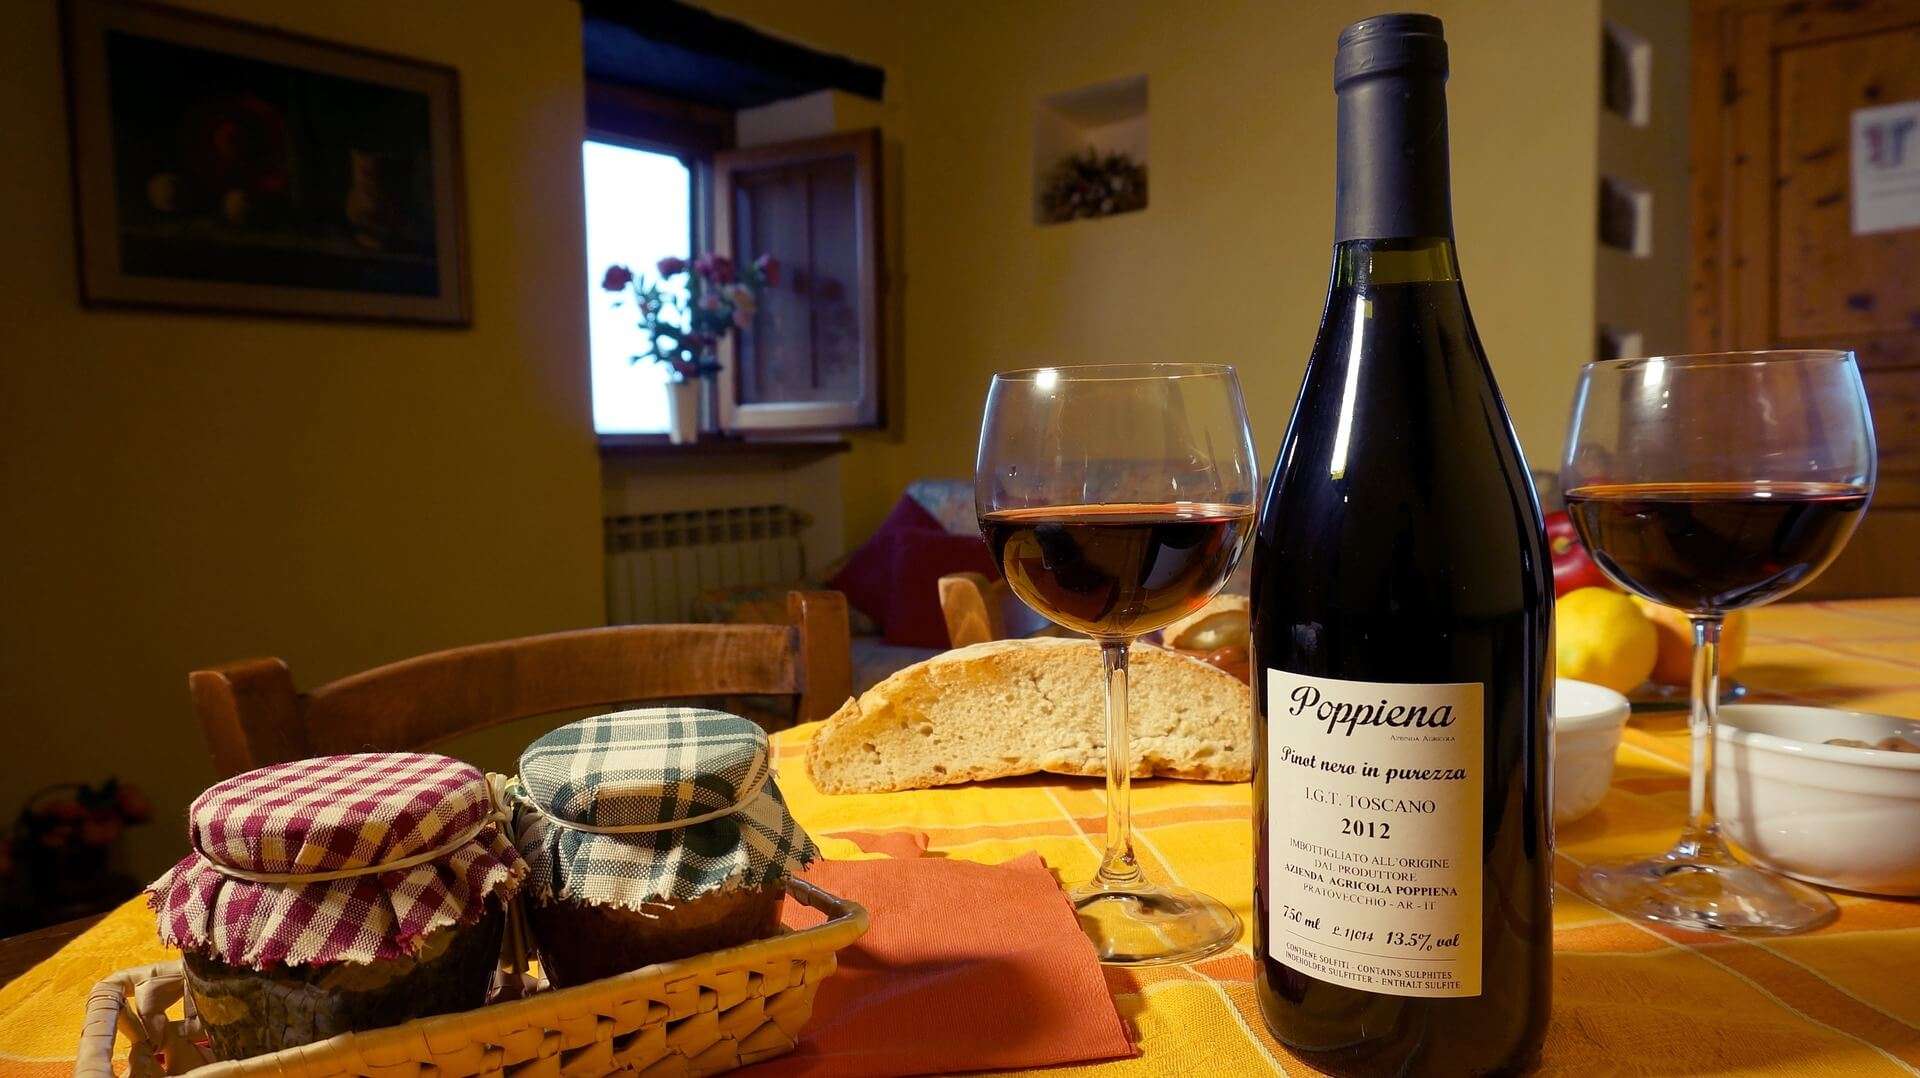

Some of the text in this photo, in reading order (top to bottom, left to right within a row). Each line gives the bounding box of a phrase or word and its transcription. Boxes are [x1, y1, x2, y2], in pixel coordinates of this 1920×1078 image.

[1289, 686, 1456, 737] Poppiena
[1280, 745, 1468, 784] Pinot nero in purezza
[1305, 786, 1436, 814] I.G.T. TOSCANO
[1341, 818, 1391, 840] 2012
[1290, 837, 1368, 863] IMBOTTIGLIATO
[1284, 863, 1458, 897] AZIENDA AGRICOLA POPPIENA
[1314, 859, 1417, 882] DAL PRODUTTORE
[1303, 883, 1386, 908] PRATOVECCHIO
[1397, 901, 1413, 910] AR
[1424, 900, 1436, 911] IT
[1281, 905, 1303, 923] 750
[1304, 917, 1321, 930] ml
[1386, 931, 1432, 951] 13.5%
[1436, 933, 1460, 948] vol
[1285, 950, 1327, 974] INDEHOLDER
[1328, 966, 1373, 984] SULFITTER
[1381, 977, 1422, 990] ENTHALT
[1424, 981, 1462, 991] SULFITE
[1286, 942, 1318, 961] CONTIENE
[1319, 954, 1350, 970] SOLFITI
[1357, 964, 1402, 978] CONTAINS
[1404, 970, 1453, 980] SULPHITES
